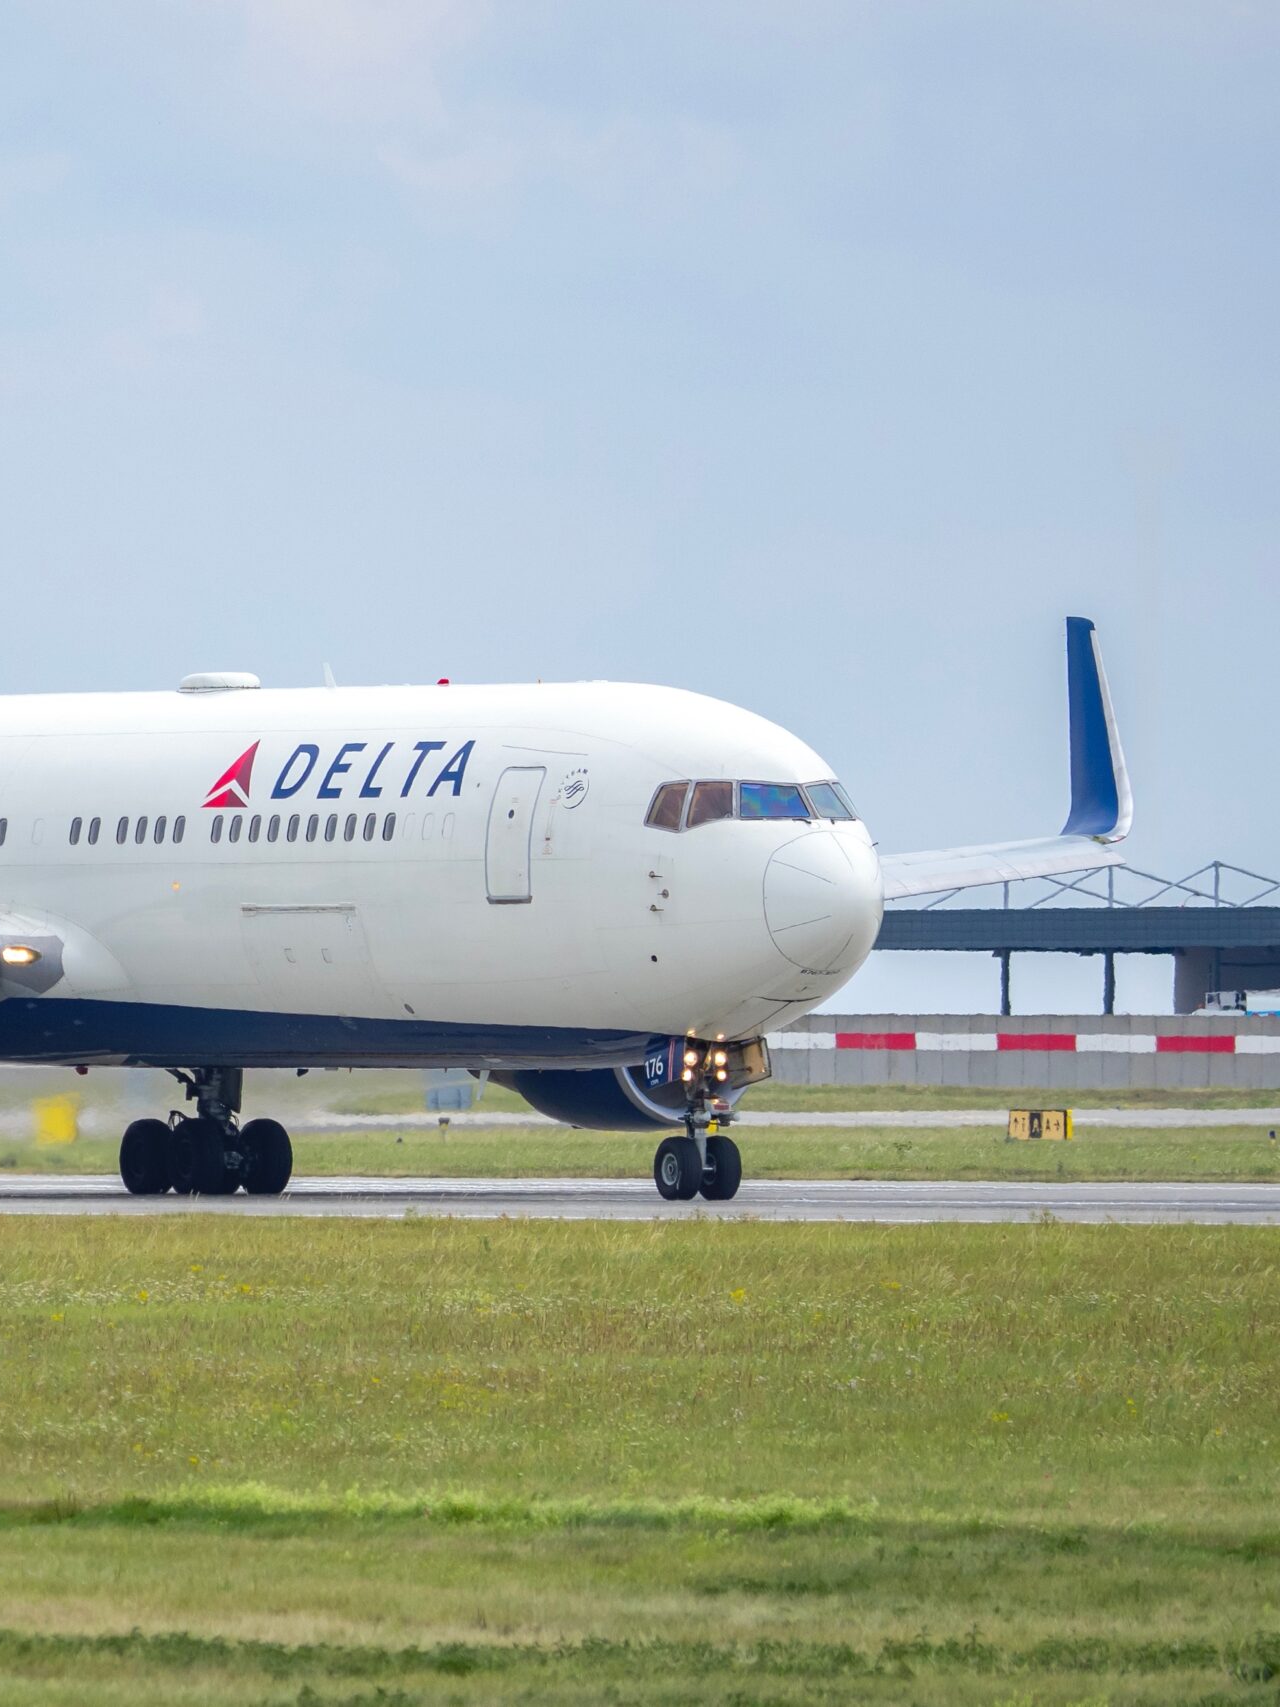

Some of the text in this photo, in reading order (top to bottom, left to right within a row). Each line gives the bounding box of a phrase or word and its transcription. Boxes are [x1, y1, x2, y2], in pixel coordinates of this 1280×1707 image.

[270, 740, 476, 799] DELTA
[644, 1054, 664, 1079] 176
[1031, 1117, 1040, 1133] A
